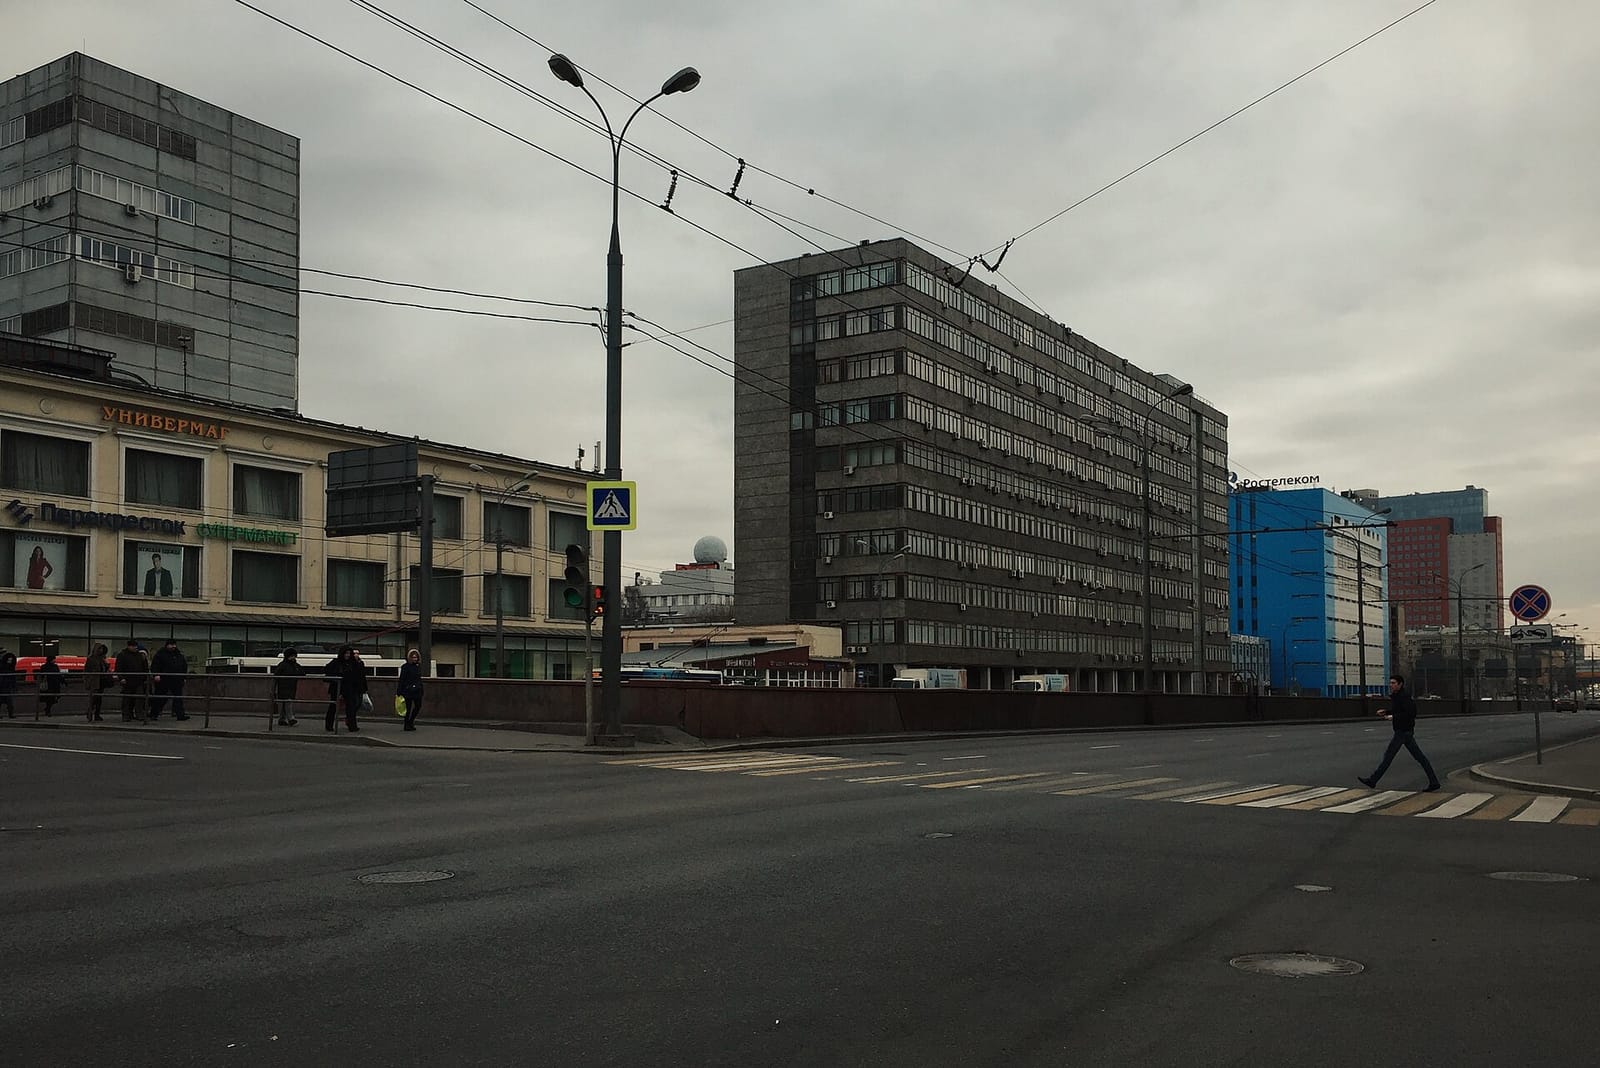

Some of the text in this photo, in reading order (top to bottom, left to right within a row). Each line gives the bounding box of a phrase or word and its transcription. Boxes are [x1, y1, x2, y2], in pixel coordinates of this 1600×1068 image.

[102, 405, 231, 440] УНИВЕРМАГ
[1243, 475, 1320, 489] Ростелеком
[196, 522, 300, 545] СУПЕРМАРКЕТ
